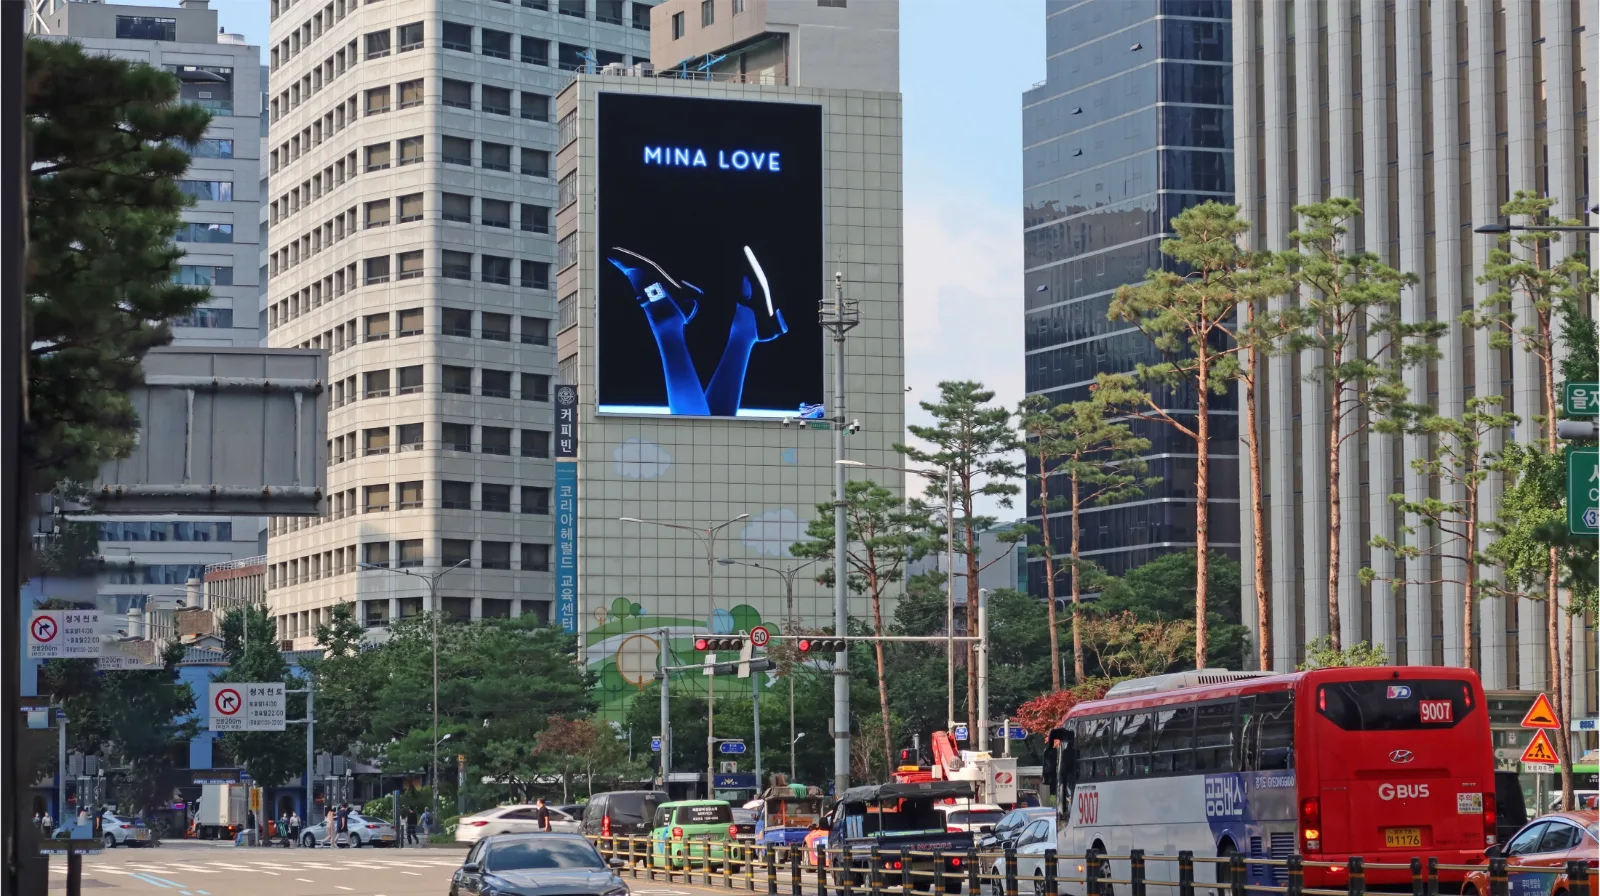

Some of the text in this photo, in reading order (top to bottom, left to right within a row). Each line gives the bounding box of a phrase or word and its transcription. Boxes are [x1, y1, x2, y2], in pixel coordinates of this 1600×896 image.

[644, 145, 781, 171] MINA LOVE
[560, 408, 572, 453] 커피빈
[560, 485, 573, 568] 코리아헤럴드
[561, 575, 574, 631] 교육센터
[754, 631, 766, 642] 50
[249, 688, 283, 696] 청계천로
[1421, 702, 1451, 720] 9007
[1078, 791, 1099, 825] 9007
[1206, 776, 1243, 817] 공공버스
